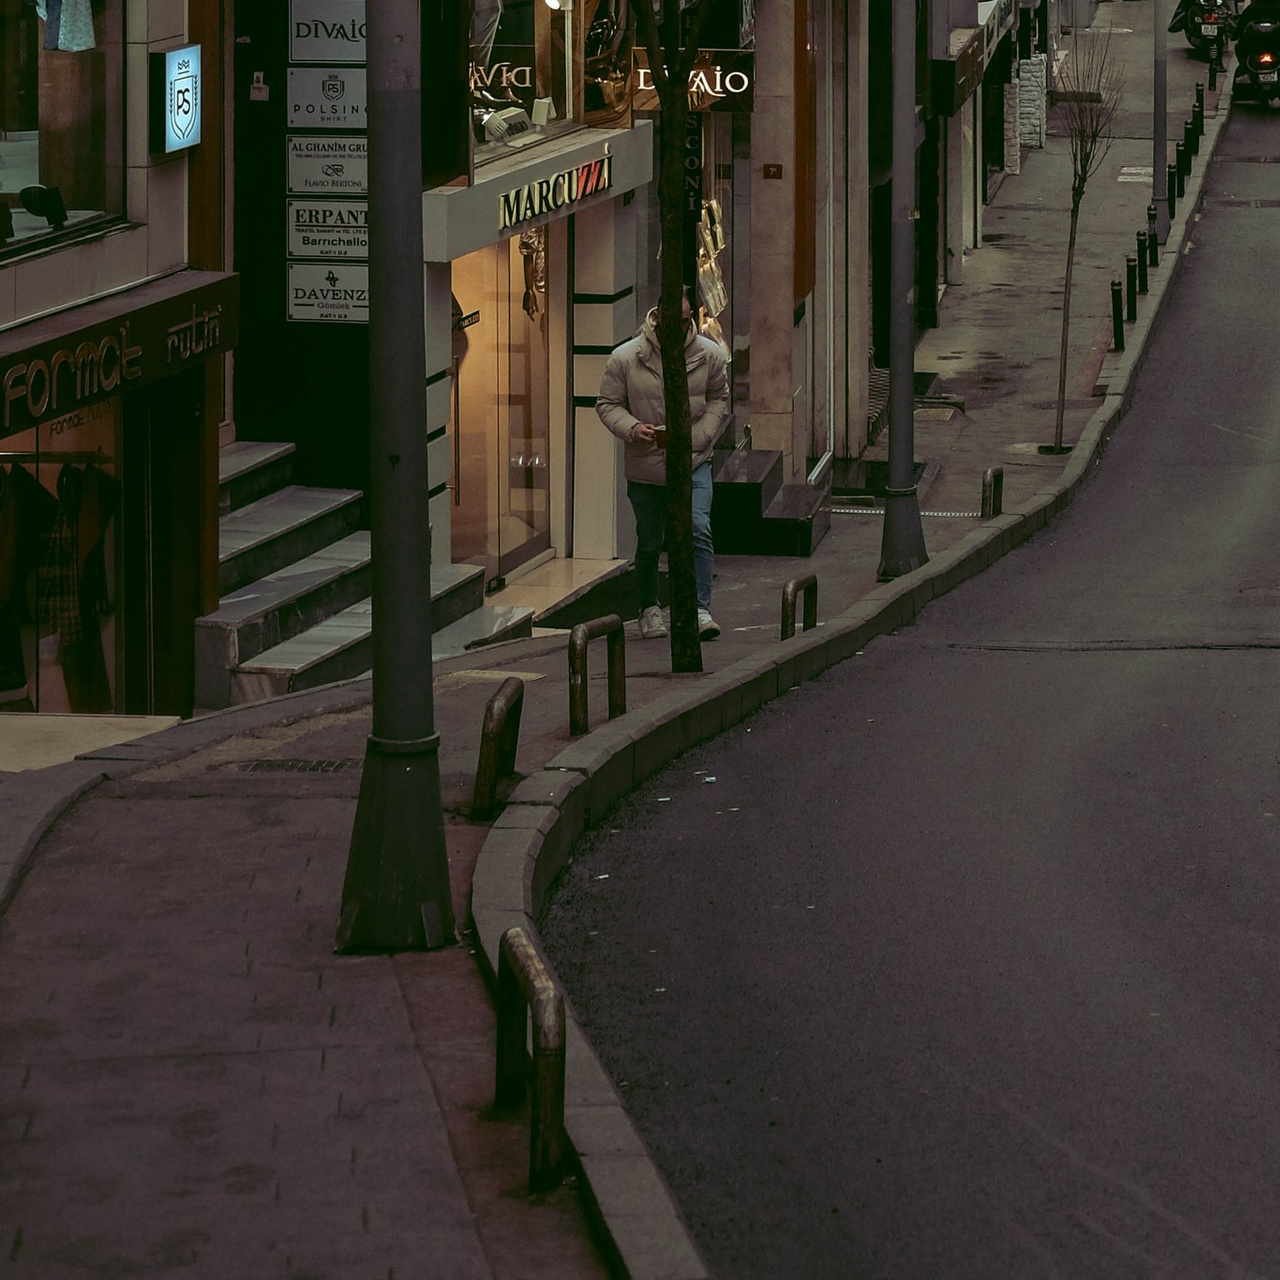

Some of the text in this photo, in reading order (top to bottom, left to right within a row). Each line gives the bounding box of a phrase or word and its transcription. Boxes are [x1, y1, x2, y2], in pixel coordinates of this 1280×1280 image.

[294, 104, 367, 114] POLSIN
[291, 143, 304, 152] AL
[348, 143, 367, 153] GRU
[295, 209, 367, 225] ERPANT
[294, 288, 369, 301] DAVENZ
